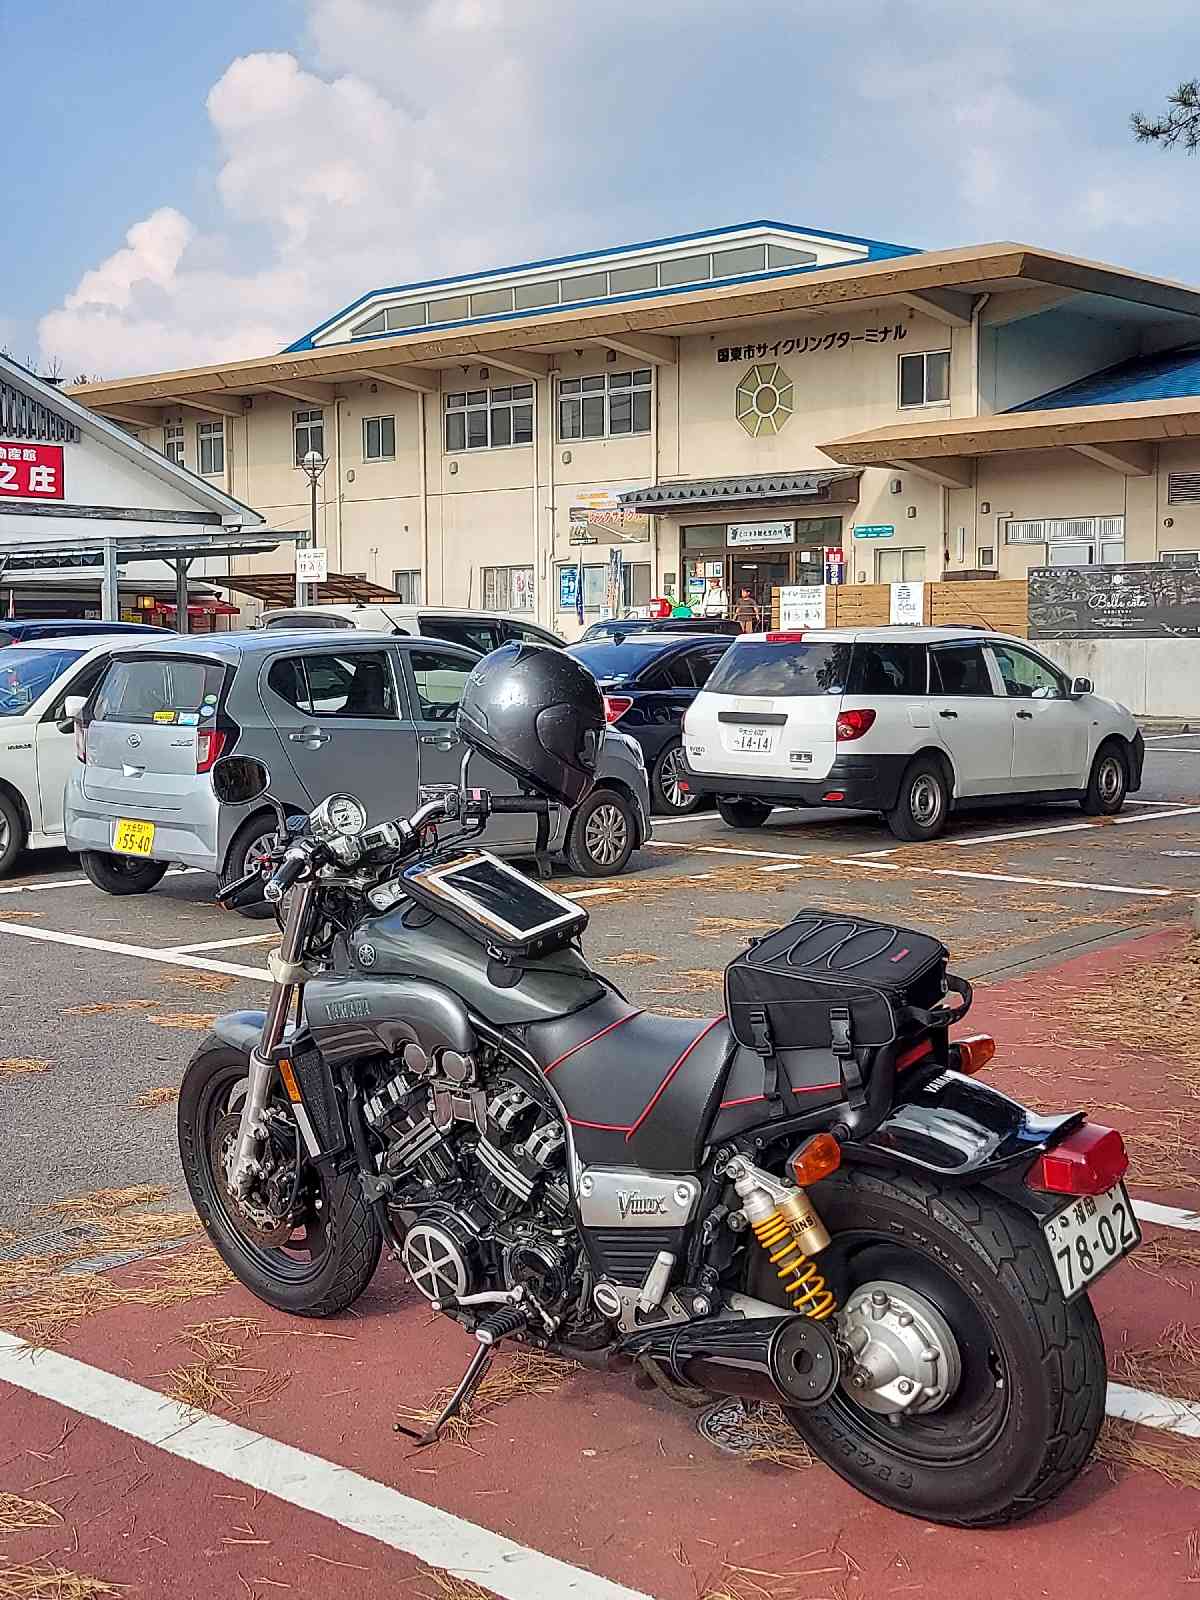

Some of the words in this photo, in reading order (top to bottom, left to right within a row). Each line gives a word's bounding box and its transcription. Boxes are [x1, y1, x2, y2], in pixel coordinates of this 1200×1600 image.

[717, 325, 907, 363] 国東市サイクリングターミナル
[741, 736, 769, 750] 14-14
[122, 833, 151, 853] 55-40
[1057, 1203, 1133, 1290] 78-02
